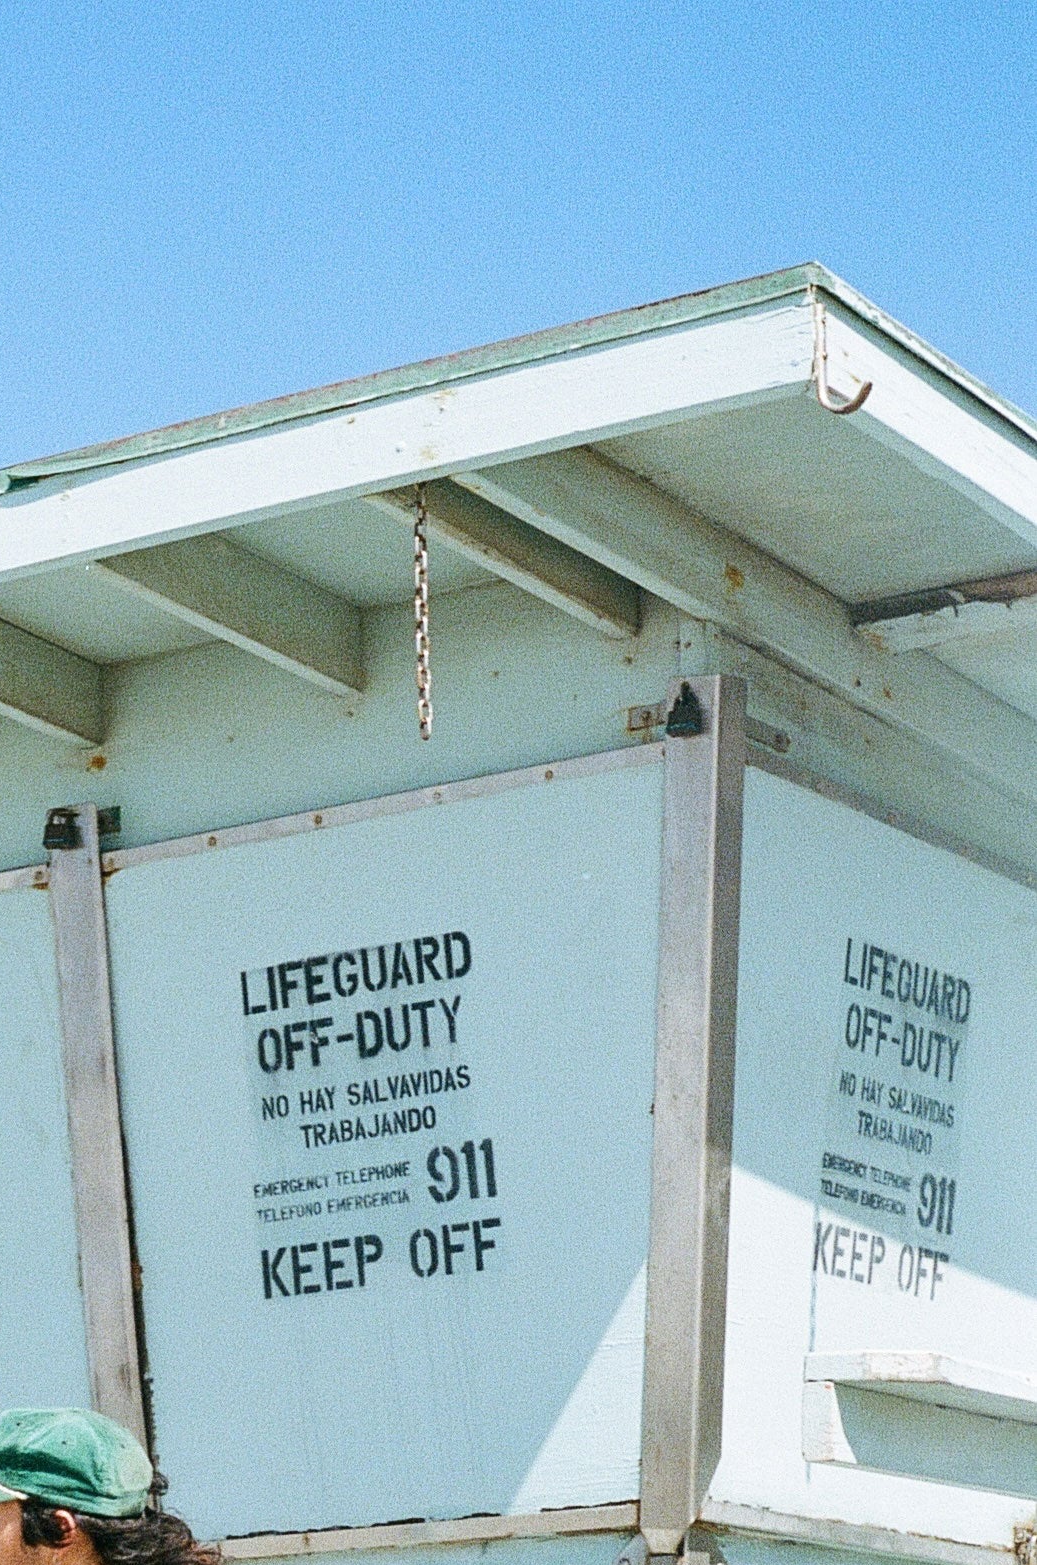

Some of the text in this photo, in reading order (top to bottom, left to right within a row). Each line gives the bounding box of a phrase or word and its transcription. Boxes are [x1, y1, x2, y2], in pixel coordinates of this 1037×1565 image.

[241, 931, 472, 1016] LIFEGUARD
[843, 938, 971, 1024] LIFEGUARD
[258, 995, 461, 1074] OFF-DUTY
[844, 1003, 960, 1083] OFF-DUTY
[262, 1065, 471, 1120] NO HAY SALVAVIDAS
[839, 1069, 955, 1128] NO HAY SALVAVIDAS
[300, 1105, 436, 1148] TRABAJANDO
[857, 1110, 932, 1155] TRABAJANDO
[253, 1161, 410, 1199] EMERGENCY TELEPHONE
[327, 1189, 410, 1214] EMERGENCIA
[427, 1138, 497, 1204] 911
[917, 1172, 957, 1235] 911
[261, 1217, 501, 1299] KEEP OFF
[812, 1221, 949, 1300] KEEP OFF
